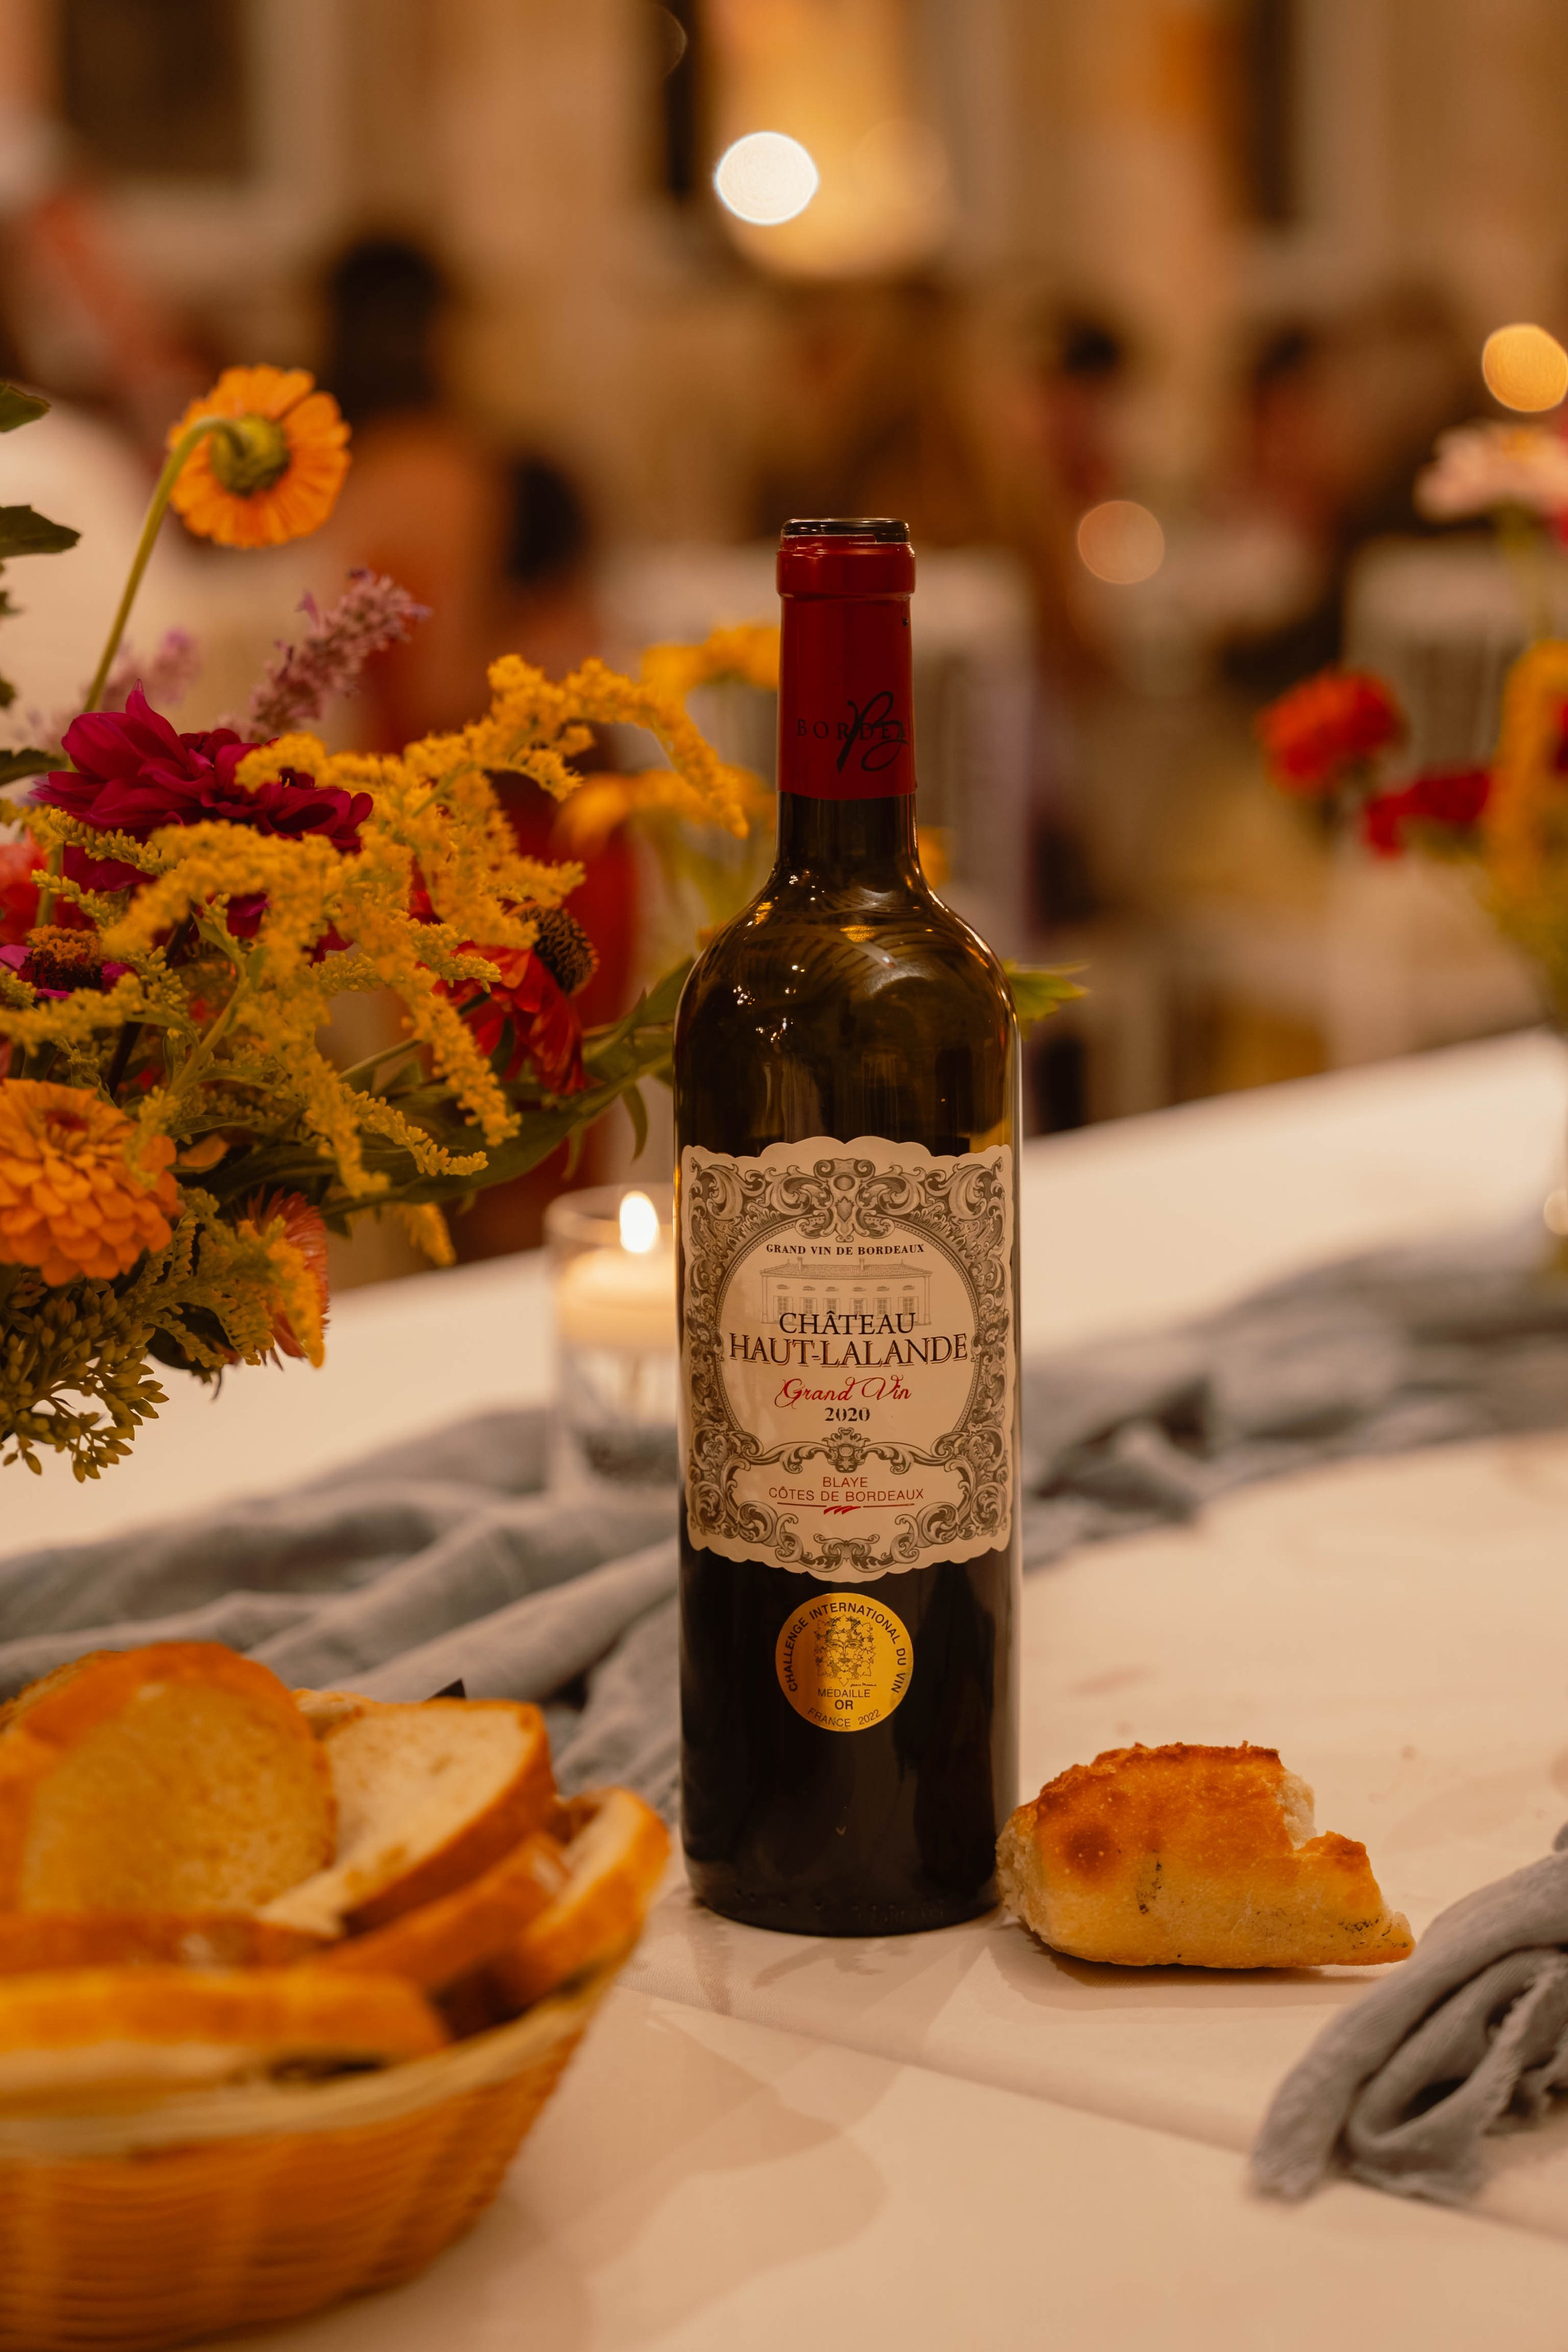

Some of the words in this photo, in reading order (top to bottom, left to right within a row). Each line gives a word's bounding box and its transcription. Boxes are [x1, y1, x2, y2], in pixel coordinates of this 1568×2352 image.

[766, 1244, 806, 1254] GRAND
[811, 1245, 831, 1255] VIN
[836, 1246, 853, 1256] DE
[858, 1244, 924, 1255] BORDEAUX
[779, 1310, 916, 1335] CHÂTEAU
[729, 1333, 968, 1368] HAUT-LALANDE
[774, 1377, 855, 1409] Grand
[861, 1374, 911, 1401] Vin
[824, 1407, 870, 1422] 2020
[823, 1477, 868, 1488] BLAYE
[769, 1487, 815, 1501] CÔTES
[821, 1491, 839, 1501] DE
[846, 1488, 924, 1502] BORDEAUX
[809, 1602, 900, 1644] INTERNATIONAL
[783, 1617, 809, 1692] CHALLENGE
[896, 1648, 907, 1666] DU
[818, 1687, 870, 1698] MÉDAILLE
[891, 1673, 906, 1694] VIN
[835, 1700, 853, 1710] OR
[807, 1707, 851, 1727] FRANCE
[858, 1709, 881, 1725] 2022
